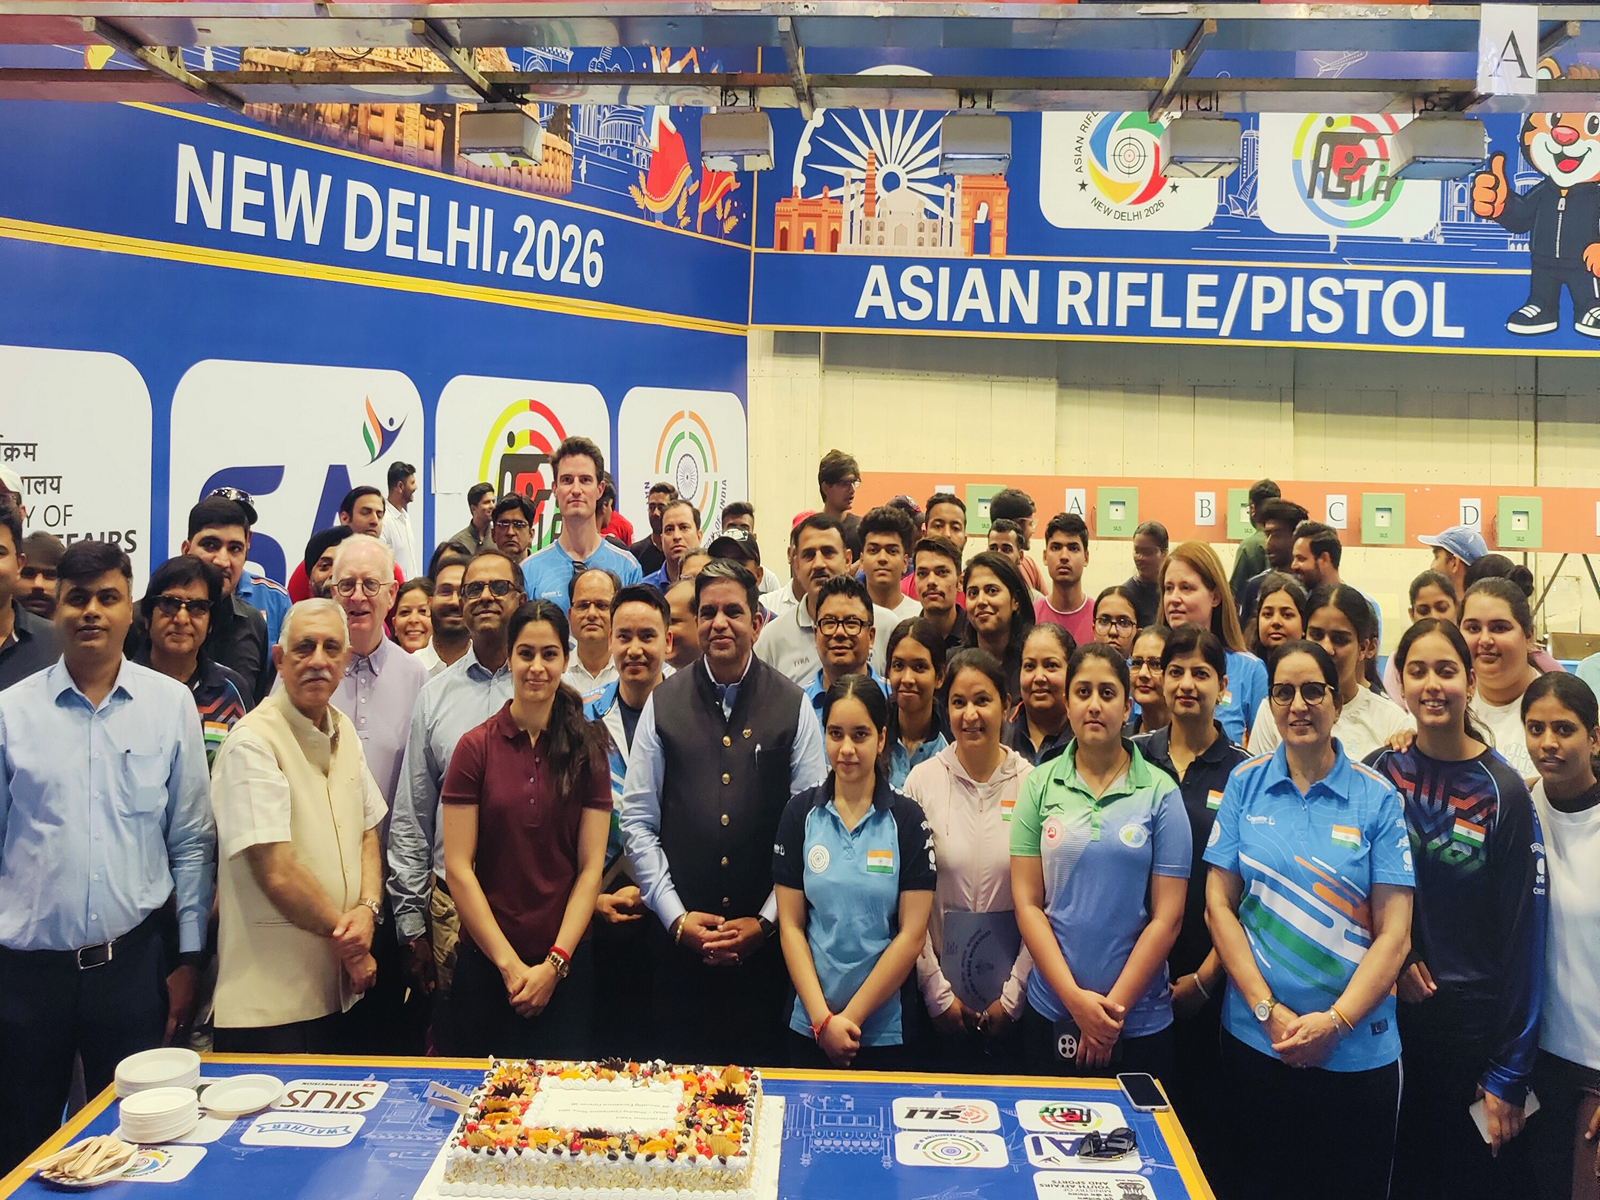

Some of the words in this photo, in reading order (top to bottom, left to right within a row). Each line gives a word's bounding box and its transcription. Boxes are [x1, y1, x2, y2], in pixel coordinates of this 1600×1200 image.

[1496, 29, 1534, 80] A
[1073, 136, 1085, 173] ASIAN
[176, 143, 333, 246] NEW
[1091, 197, 1113, 216] NEW
[1113, 210, 1142, 222] DELHI
[1145, 199, 1165, 218] 2026
[855, 265, 1040, 325] ASIAN
[1057, 270, 1465, 339] RIFLE/PISTOL
[719, 479, 728, 510] INDIA
[44, 505, 73, 527] OF
[1068, 496, 1083, 515] A
[1199, 499, 1212, 518] B
[1328, 502, 1345, 522] C
[1462, 506, 1479, 525] D
[280, 1089, 374, 1110] SIUS
[904, 1109, 962, 1120] SLI
[272, 1123, 338, 1135] WALTHER
